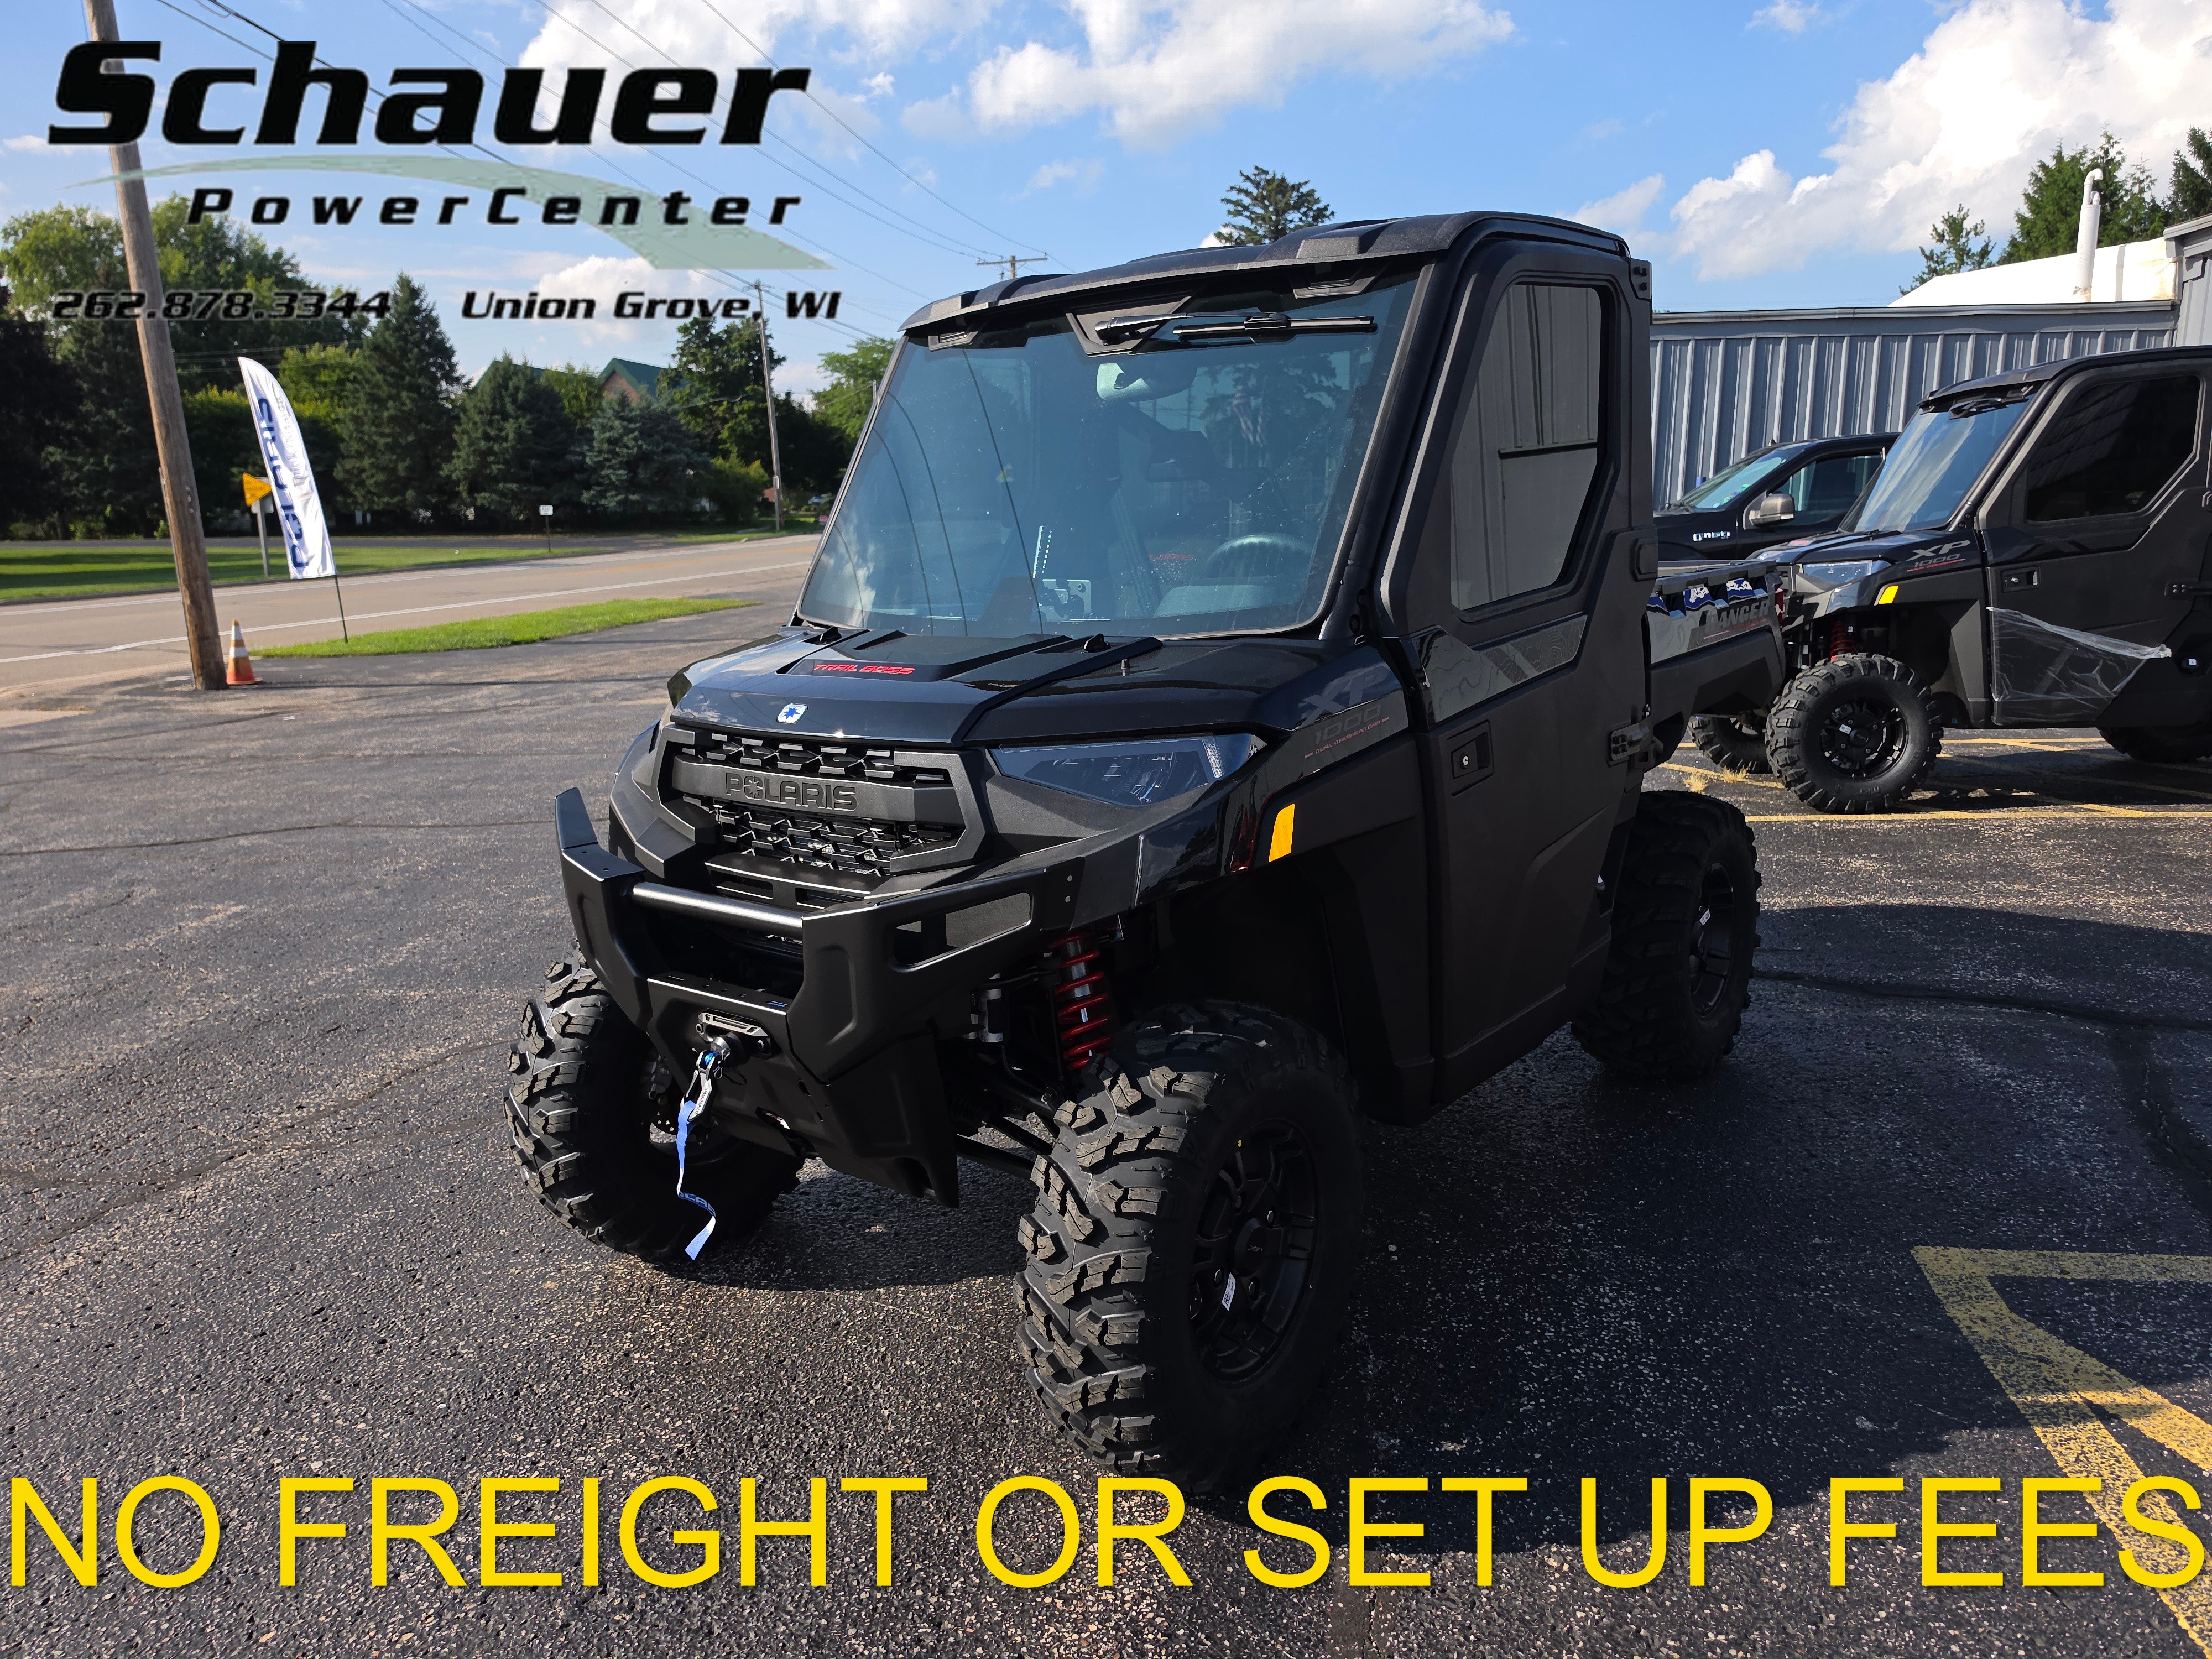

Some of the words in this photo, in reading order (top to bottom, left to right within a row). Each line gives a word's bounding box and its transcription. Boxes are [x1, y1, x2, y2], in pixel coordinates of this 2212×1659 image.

[1906, 540, 1971, 562] XP
[1913, 553, 1960, 567] 1000
[1705, 599, 1770, 632] RANGER
[859, 665, 916, 675] BOSS
[1298, 665, 1391, 729] XP
[1315, 703, 1381, 745] 1000
[725, 772, 858, 812] POLARIS
